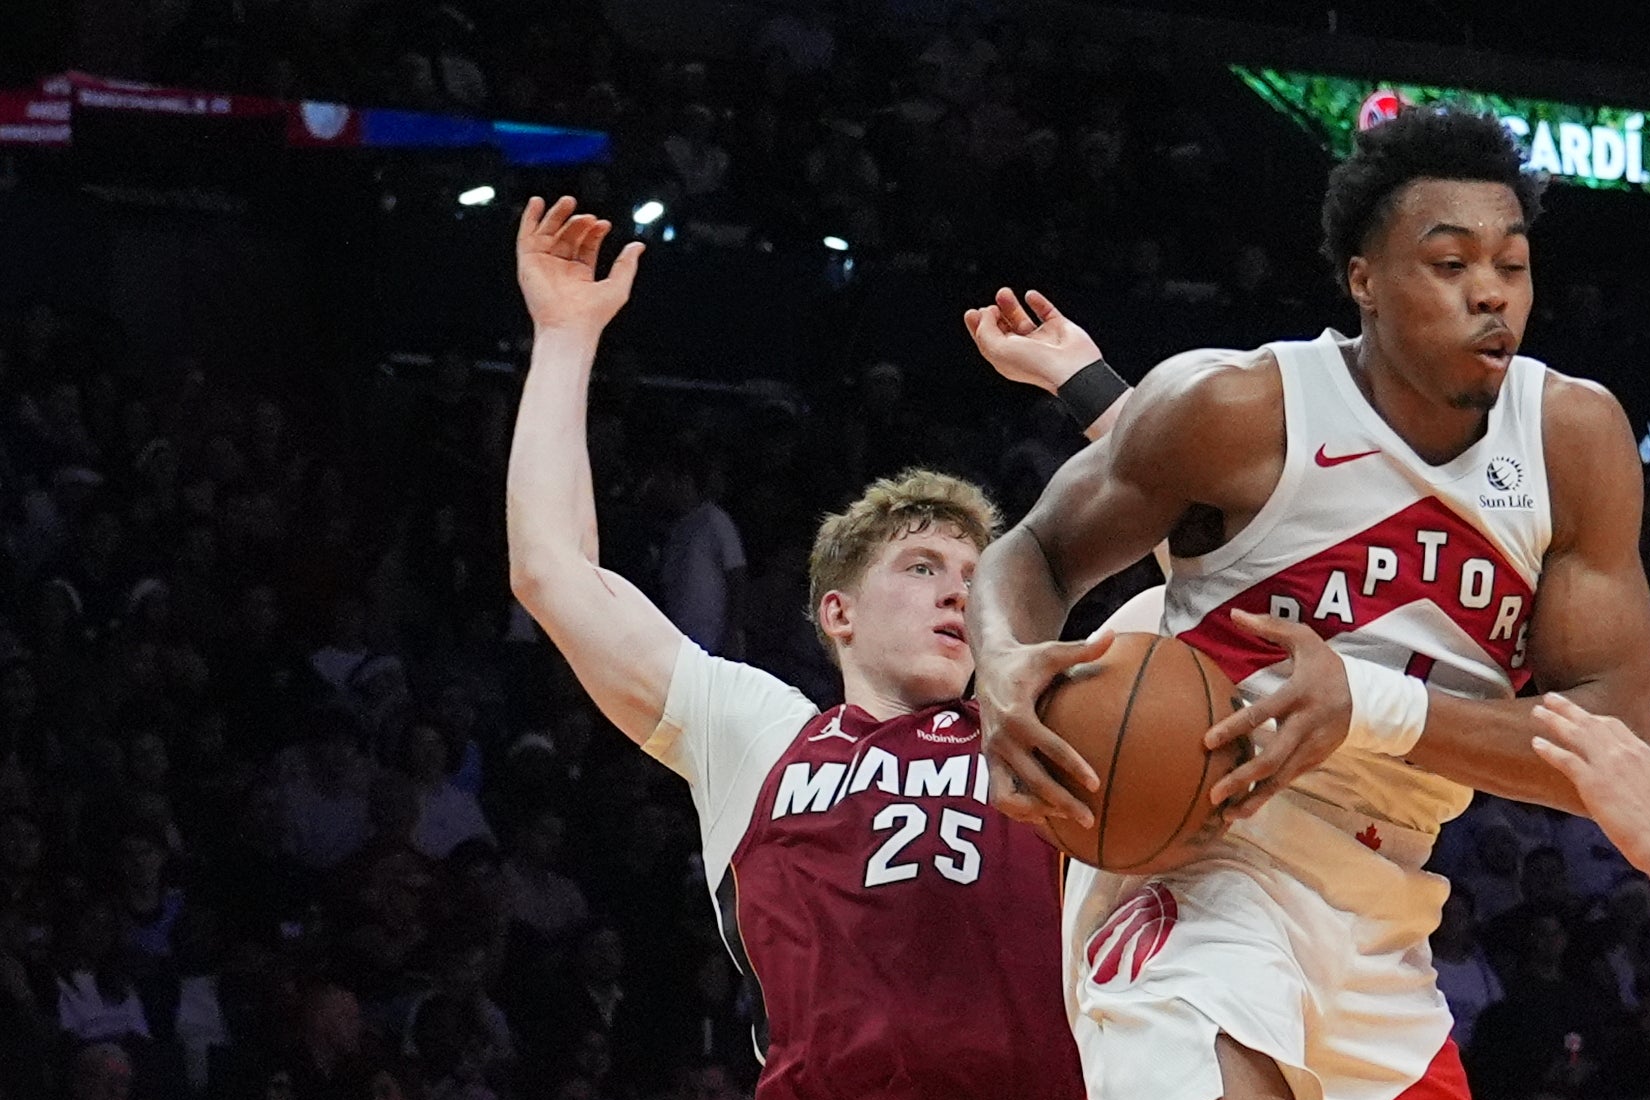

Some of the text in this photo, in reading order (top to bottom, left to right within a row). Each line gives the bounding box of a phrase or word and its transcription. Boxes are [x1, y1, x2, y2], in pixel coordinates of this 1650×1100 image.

[1479, 494, 1534, 509] Sun Life
[771, 745, 990, 821] MIAMI
[864, 802, 983, 888] 25
